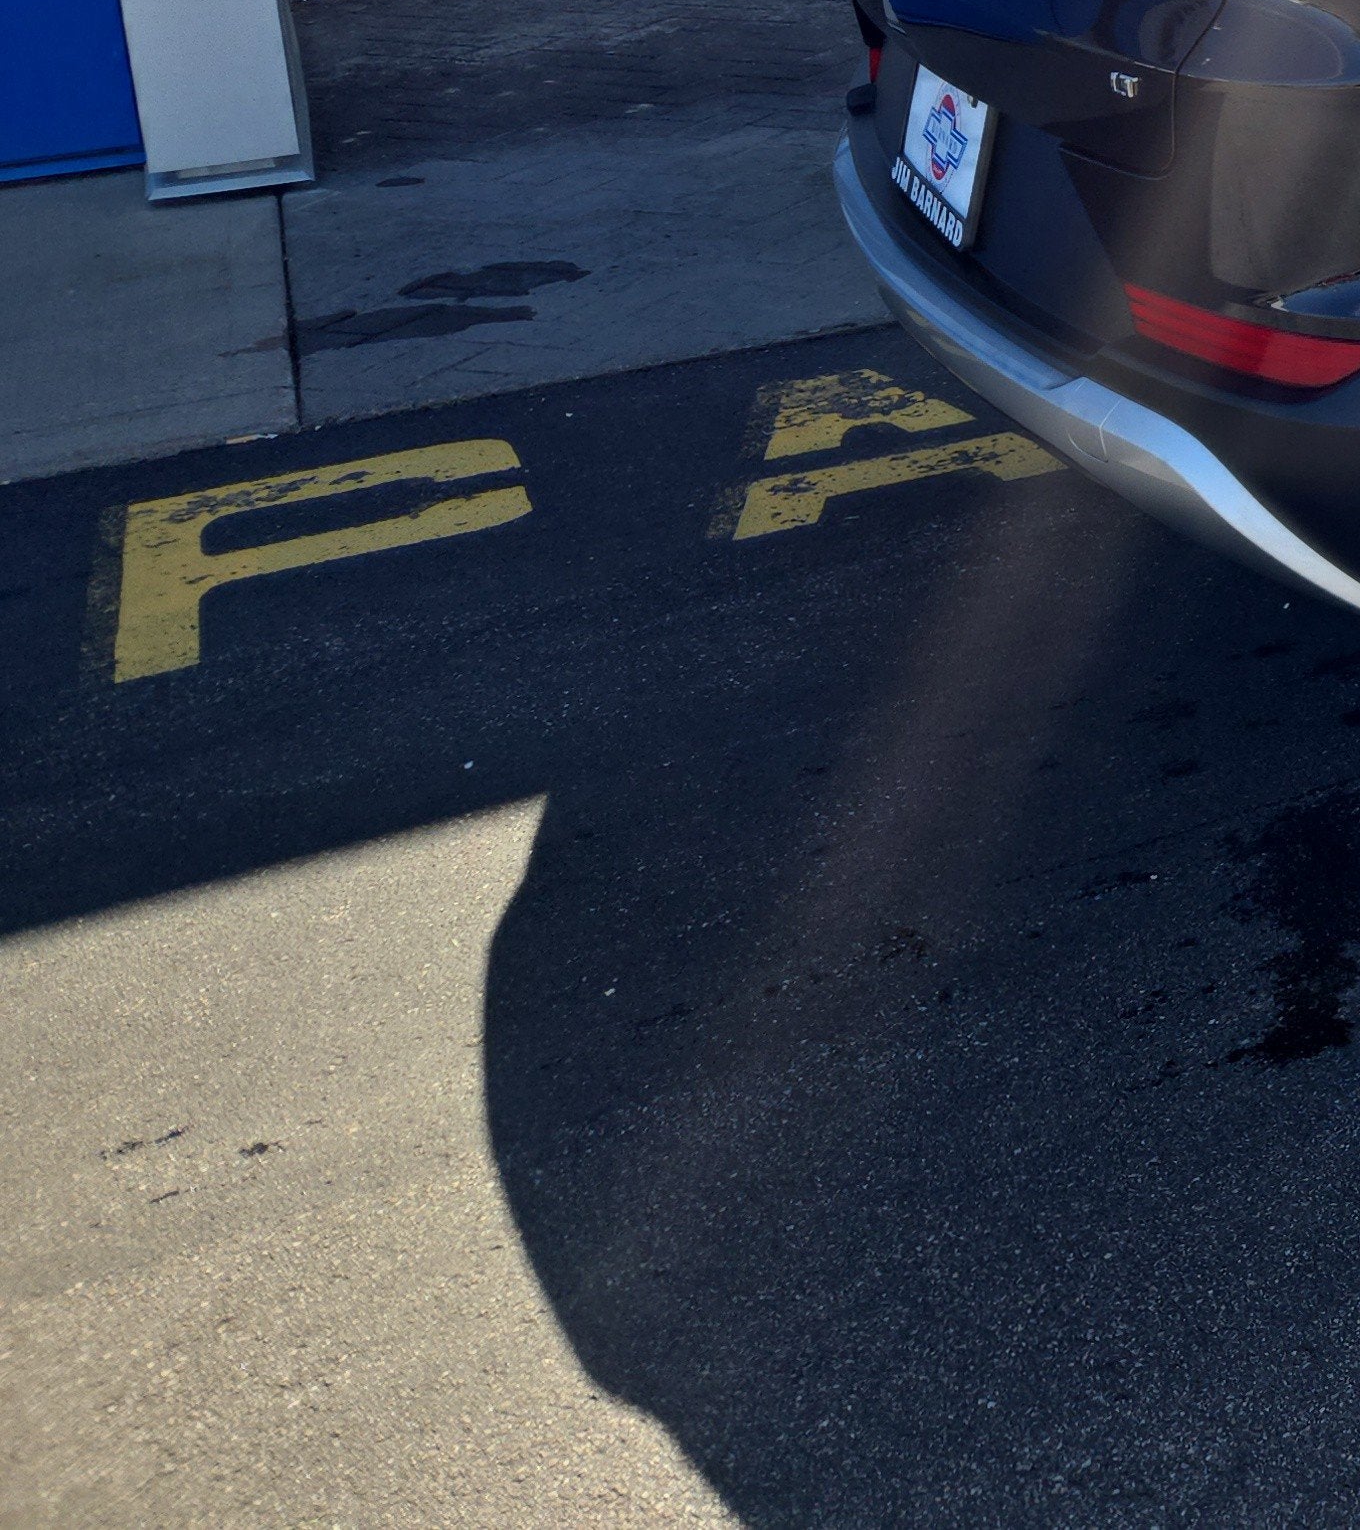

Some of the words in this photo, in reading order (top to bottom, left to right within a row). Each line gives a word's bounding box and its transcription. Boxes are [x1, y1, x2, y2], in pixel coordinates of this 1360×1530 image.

[1110, 71, 1139, 98] LT
[890, 156, 911, 193] JIM
[909, 178, 963, 248] BARNARD
